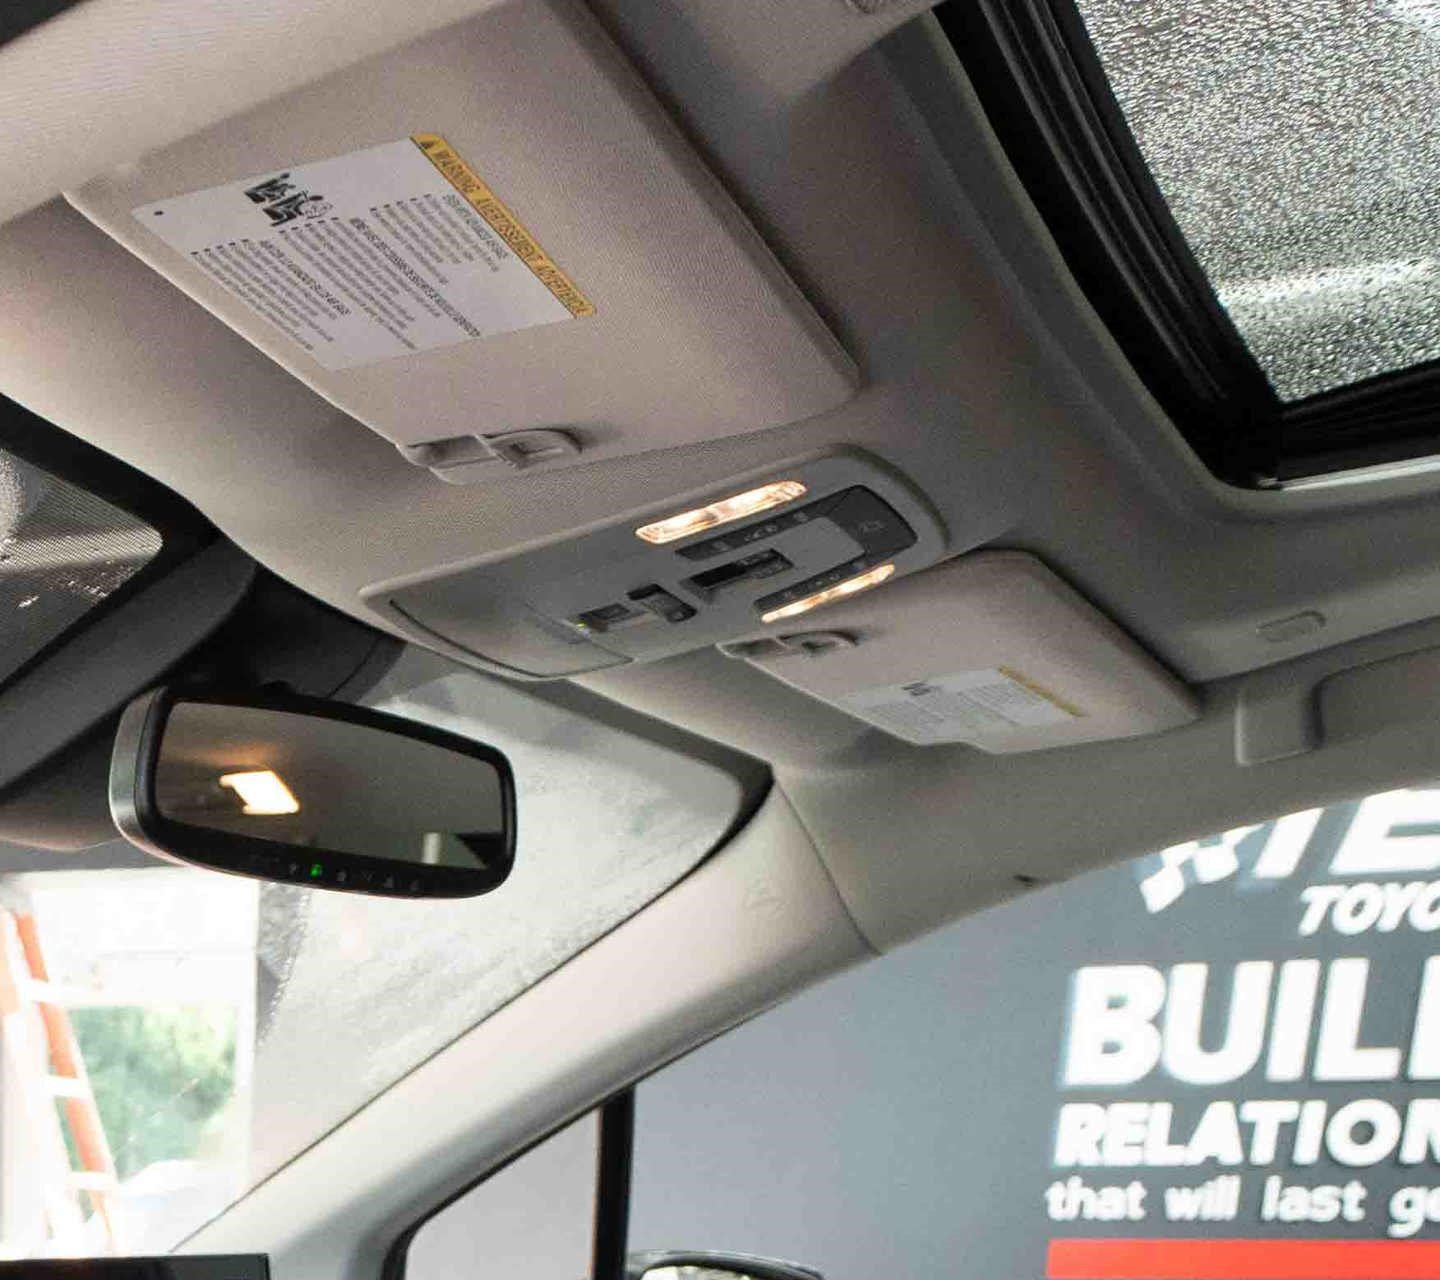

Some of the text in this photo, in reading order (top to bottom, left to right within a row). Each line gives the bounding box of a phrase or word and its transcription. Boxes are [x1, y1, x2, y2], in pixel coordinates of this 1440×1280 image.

[1045, 1175, 1147, 1221] that
[1164, 1175, 1242, 1220] will
[1261, 1175, 1367, 1222] last
